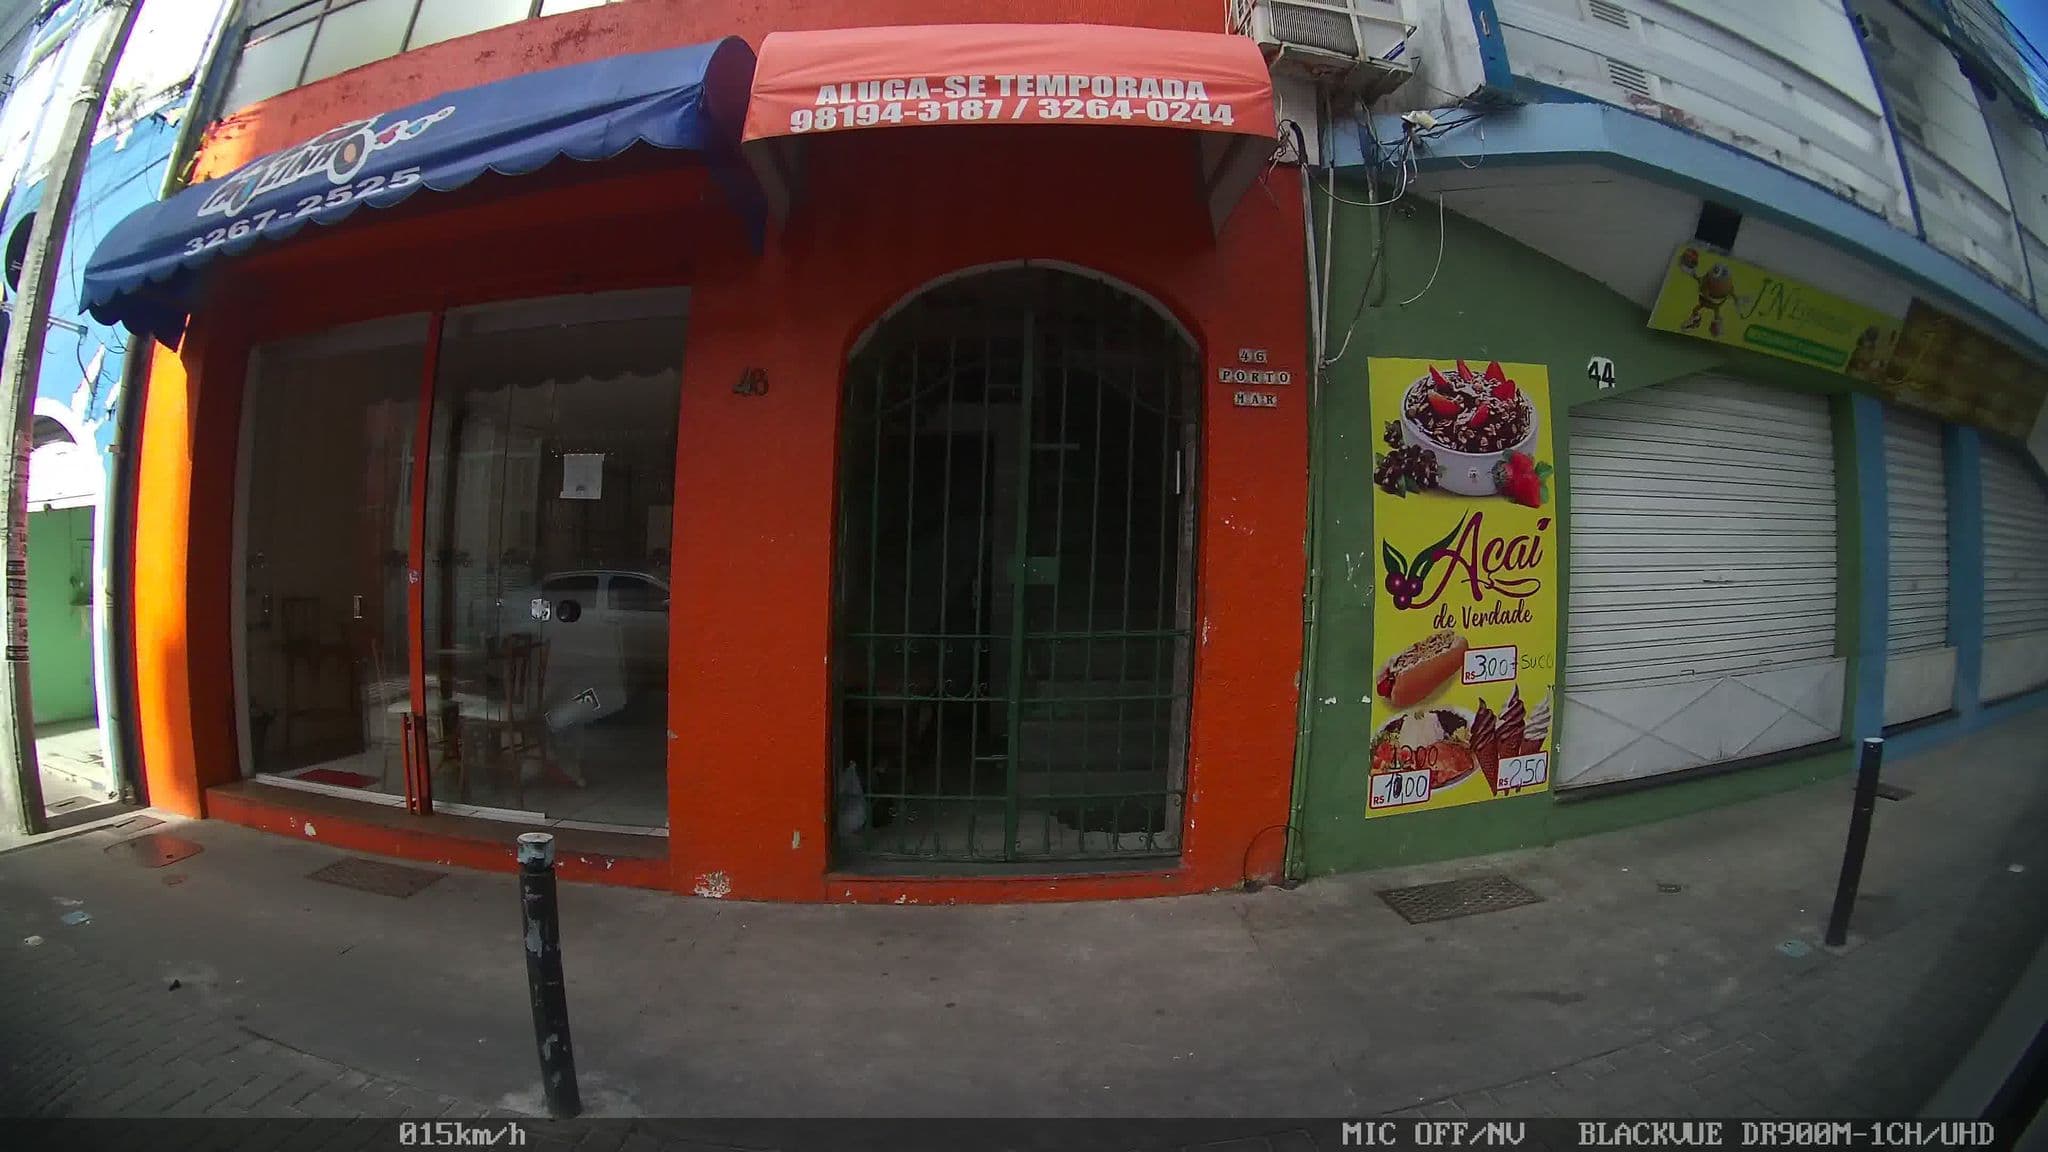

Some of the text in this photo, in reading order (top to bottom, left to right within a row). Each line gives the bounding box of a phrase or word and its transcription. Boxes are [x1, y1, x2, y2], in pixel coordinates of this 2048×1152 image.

[815, 75, 1208, 105] ALUGA-SE TEMPORADA
[789, 98, 1235, 133] 98194-3187 / 3264-0244
[184, 166, 421, 256] 3267-2525
[1240, 350, 1266, 362] 46
[1221, 370, 1289, 383] PORTO
[1587, 356, 1616, 388] 44
[1236, 393, 1275, 405] MAR
[1433, 599, 1533, 629] de Verdade
[1509, 758, 1546, 786] 2,50
